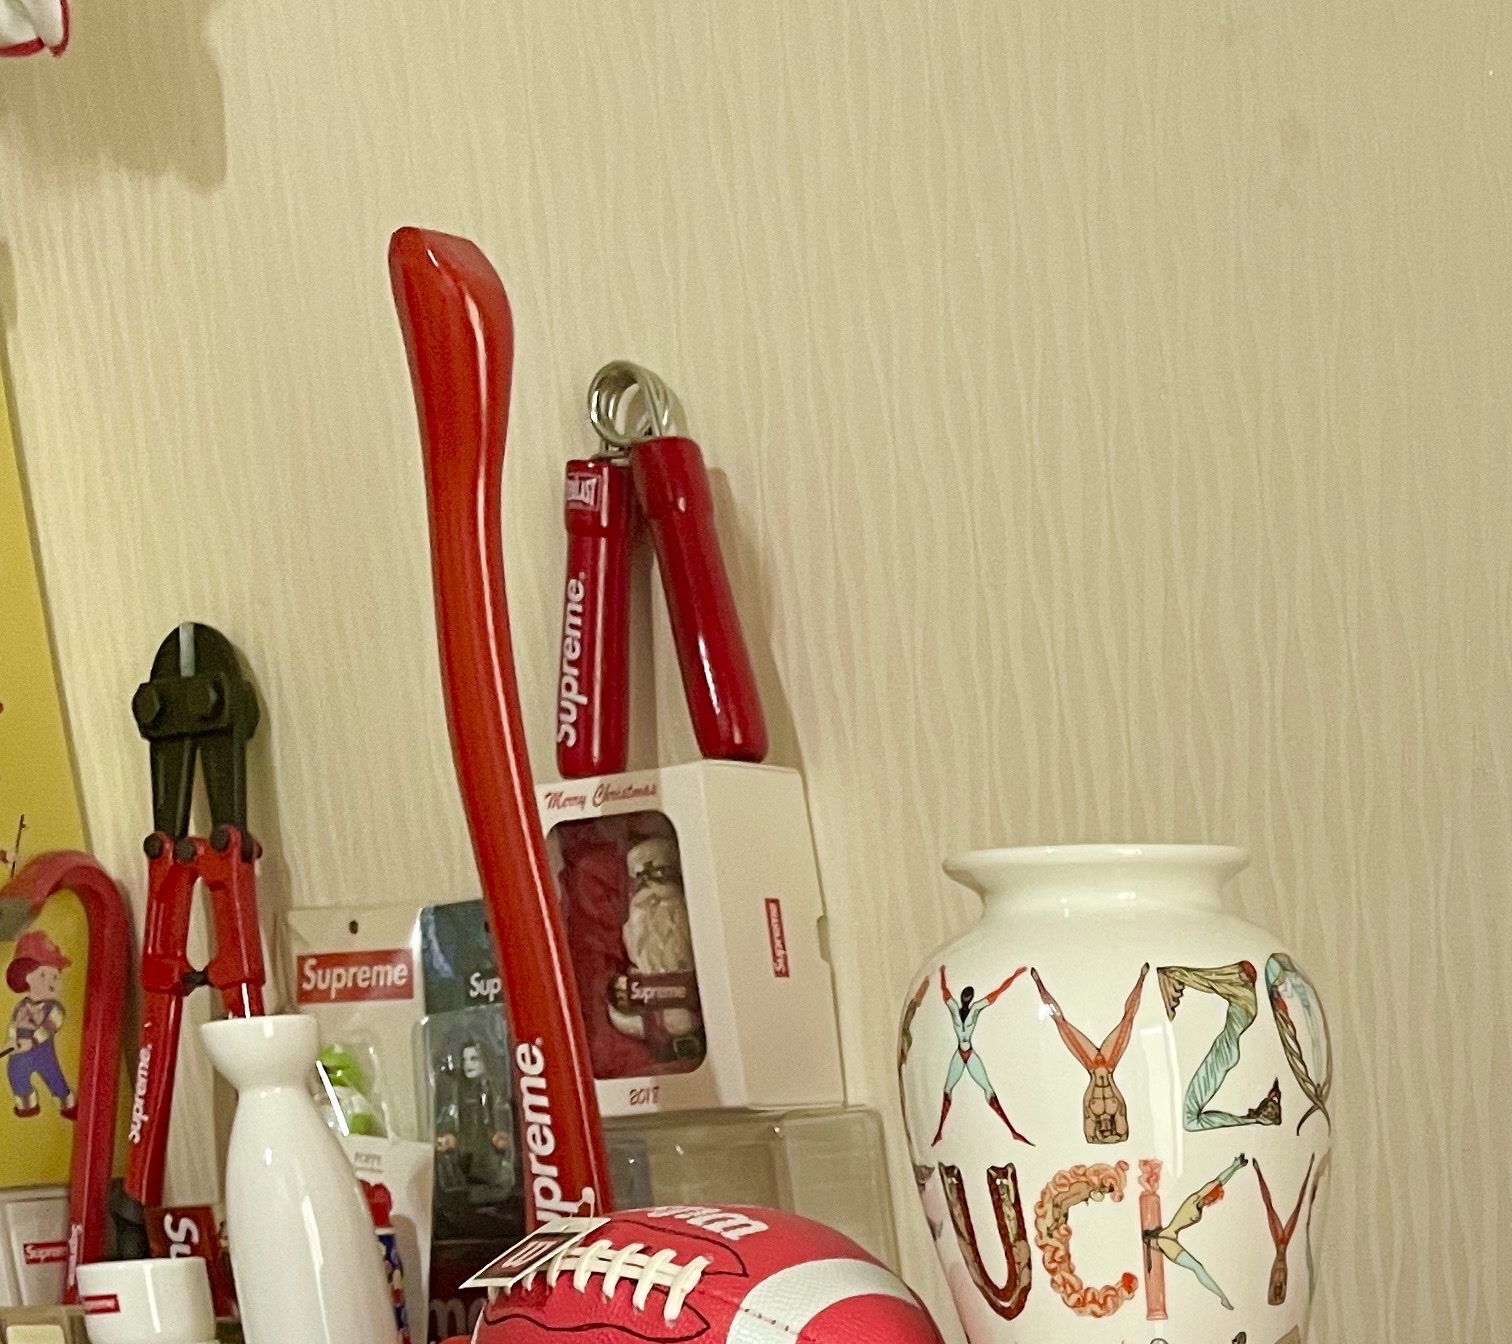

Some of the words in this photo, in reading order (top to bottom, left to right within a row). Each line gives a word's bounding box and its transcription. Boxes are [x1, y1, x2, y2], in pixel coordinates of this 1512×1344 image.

[557, 578, 588, 748] Supreme
[592, 783, 657, 808] Christmas
[769, 902, 788, 973] Supreme
[302, 958, 409, 999] Supreme
[630, 979, 687, 1003] Supreme
[128, 1046, 152, 1144] Supreme
